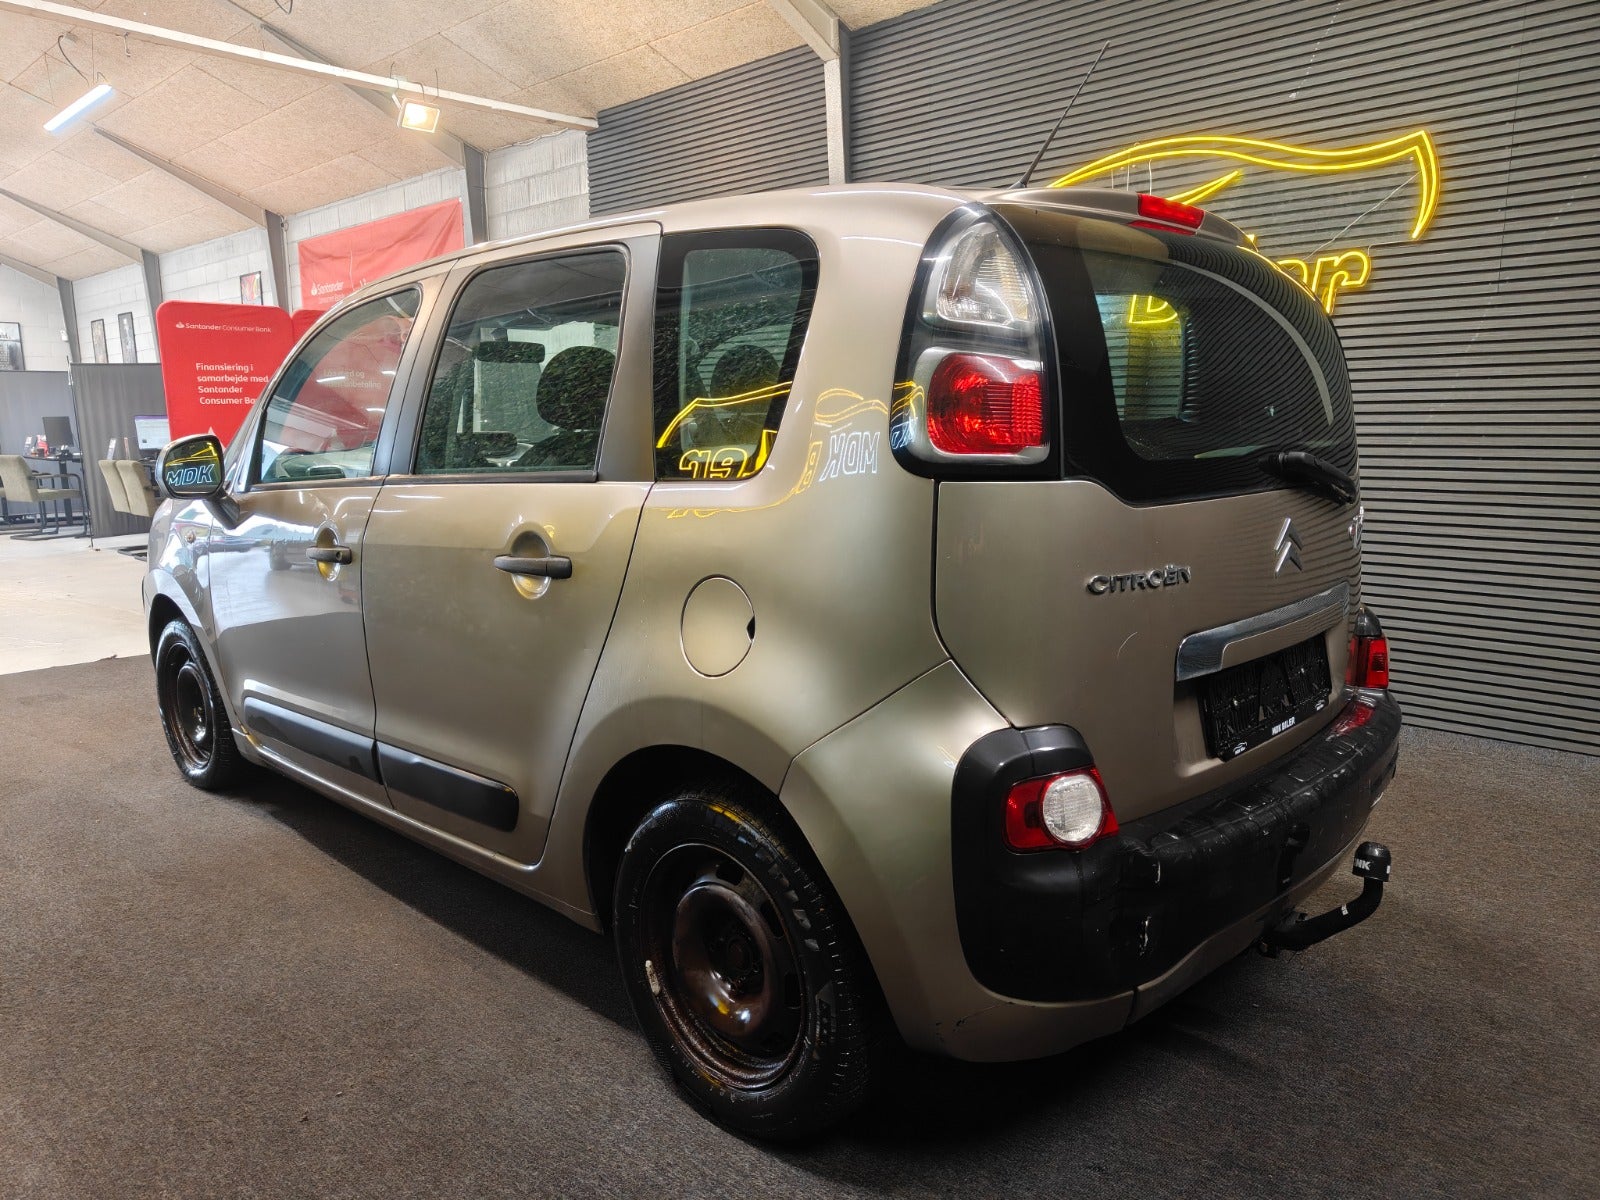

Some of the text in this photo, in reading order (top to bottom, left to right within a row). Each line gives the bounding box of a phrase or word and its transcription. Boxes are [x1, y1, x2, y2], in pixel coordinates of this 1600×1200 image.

[185, 322, 221, 331] Santander
[222, 324, 254, 332] Consumer
[195, 362, 249, 373] Finansiering
[197, 374, 269, 384] samarbejde med
[198, 385, 243, 394] Santander
[199, 396, 257, 405] Consumer Ba
[166, 463, 215, 487] MDK
[1086, 564, 1191, 596] CITROËN
